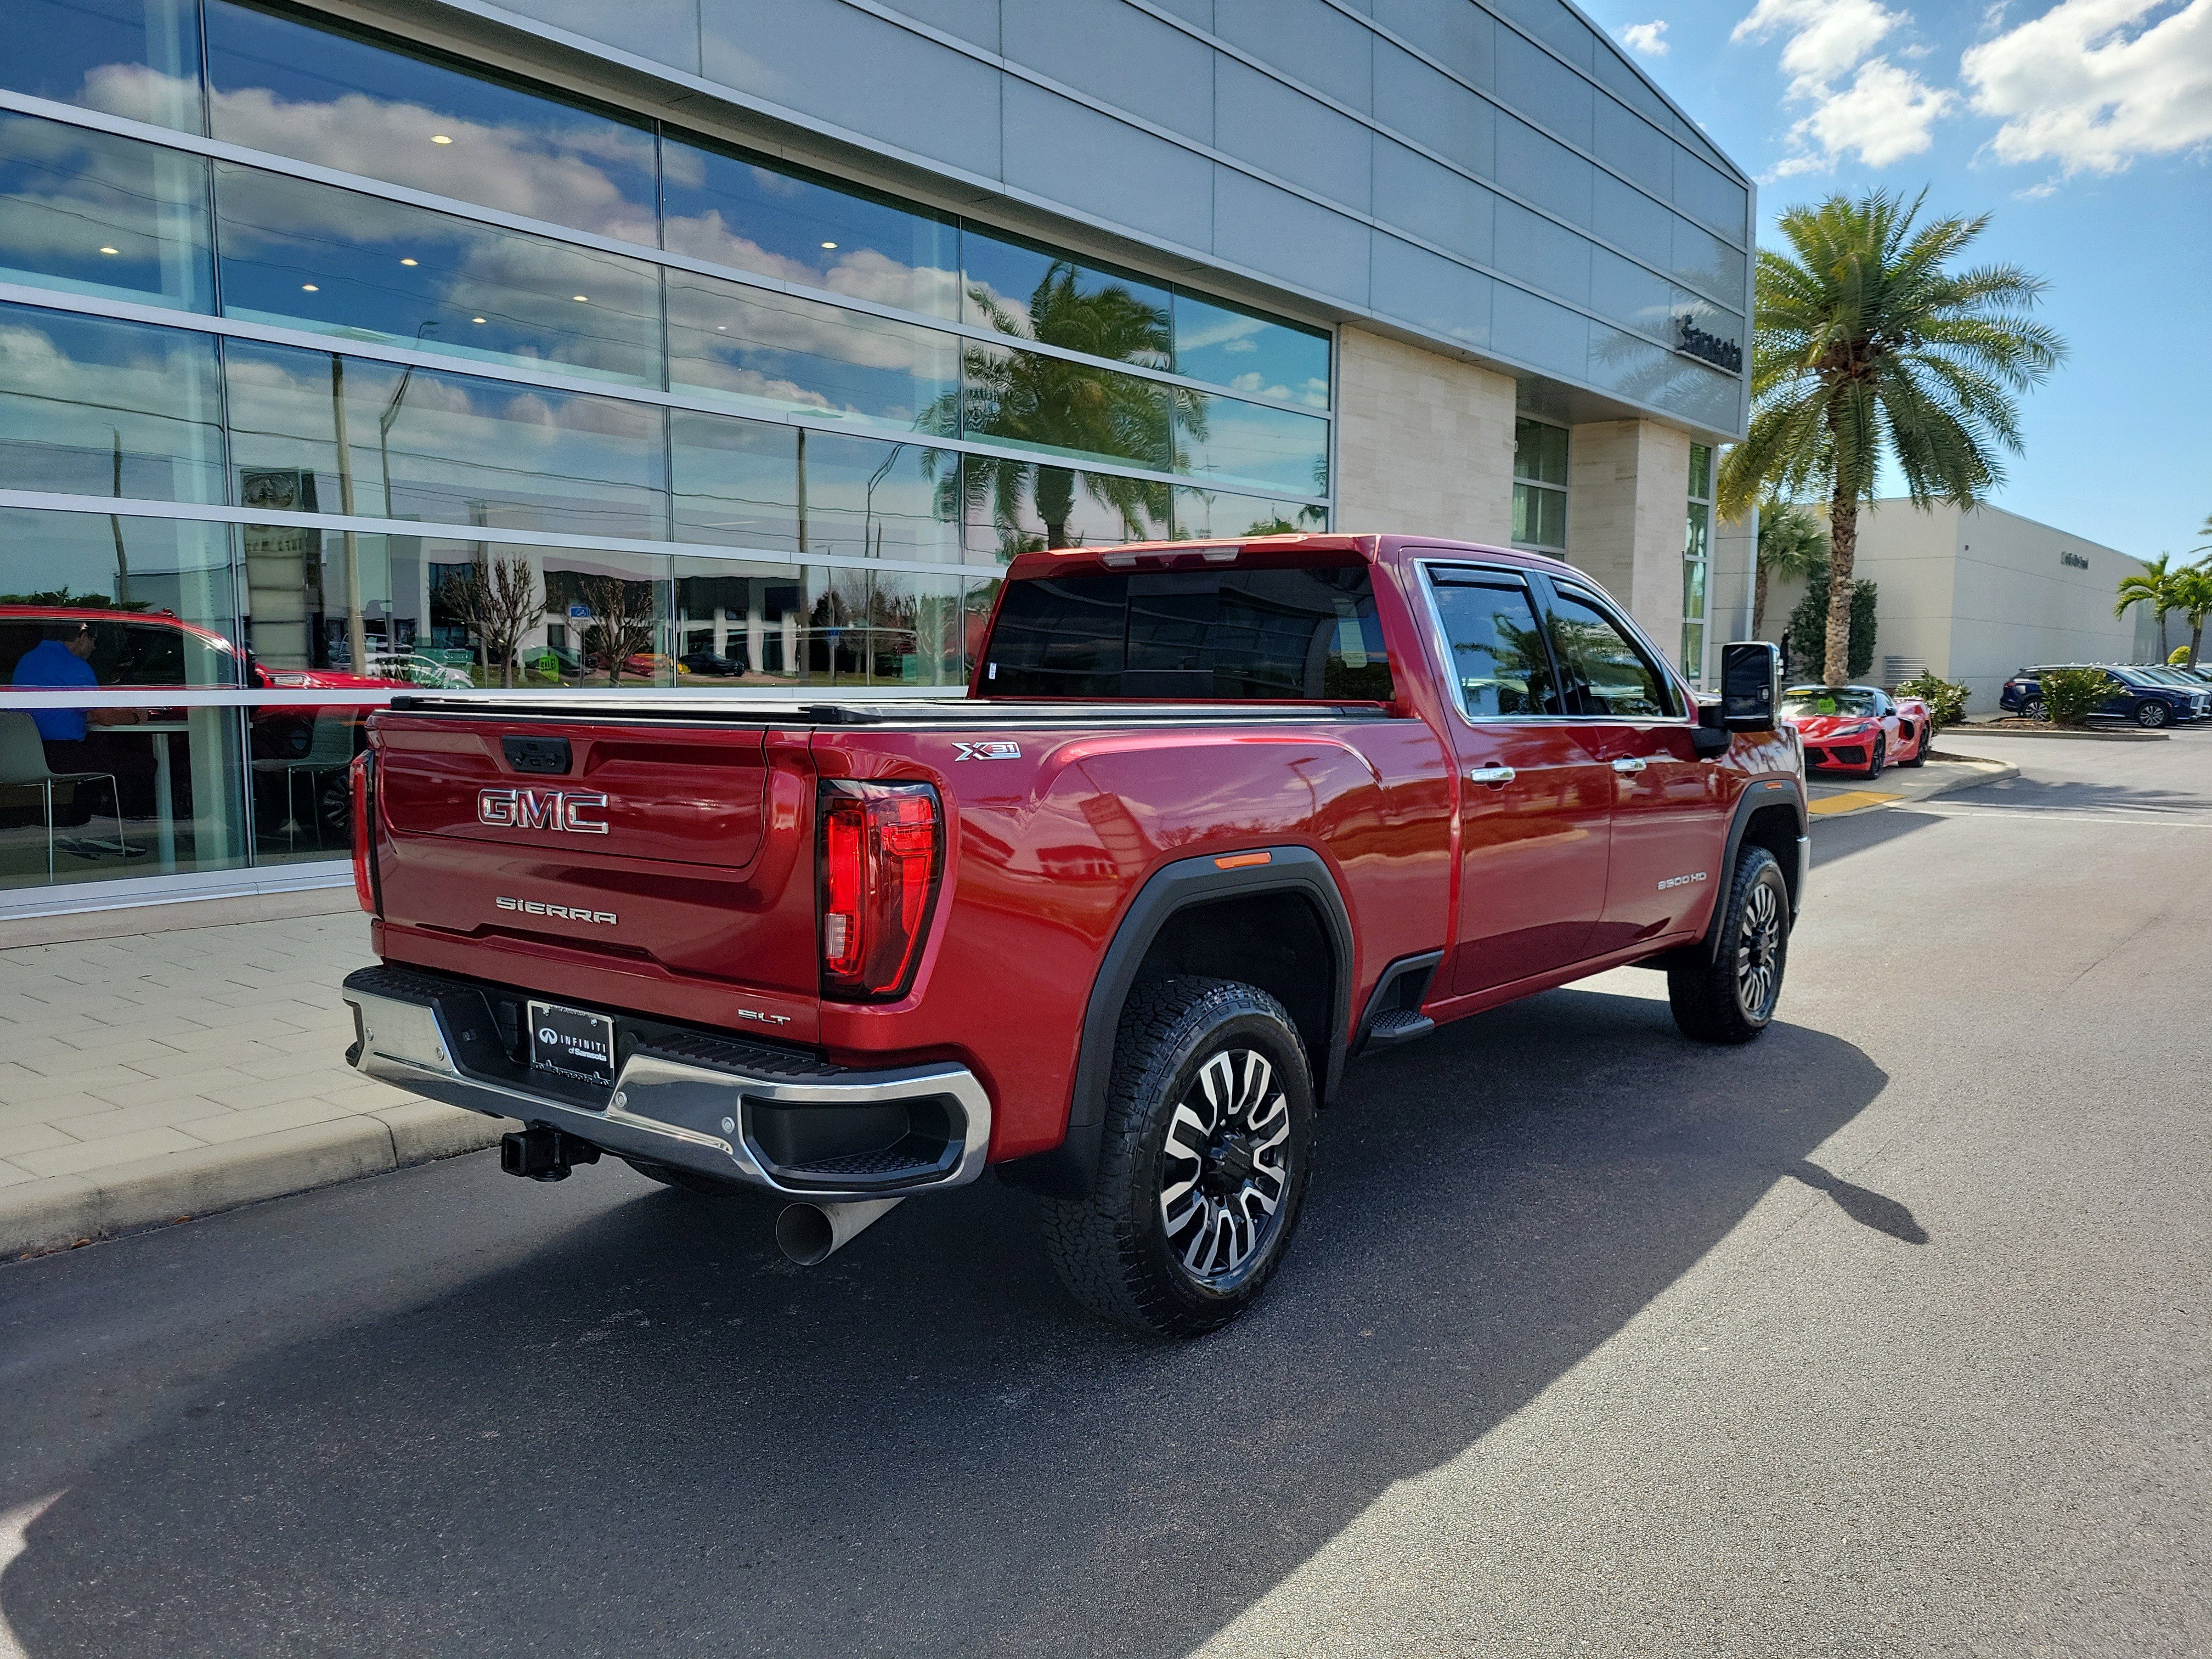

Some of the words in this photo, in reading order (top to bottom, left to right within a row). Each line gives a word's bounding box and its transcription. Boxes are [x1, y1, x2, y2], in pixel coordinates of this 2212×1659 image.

[478, 788, 609, 834] GMC
[1691, 871, 1707, 883] HD
[496, 896, 617, 926] SIERRA
[738, 1009, 791, 1025] SLT
[560, 1035, 606, 1053] INFINITI
[574, 1048, 607, 1062] Sarasota
